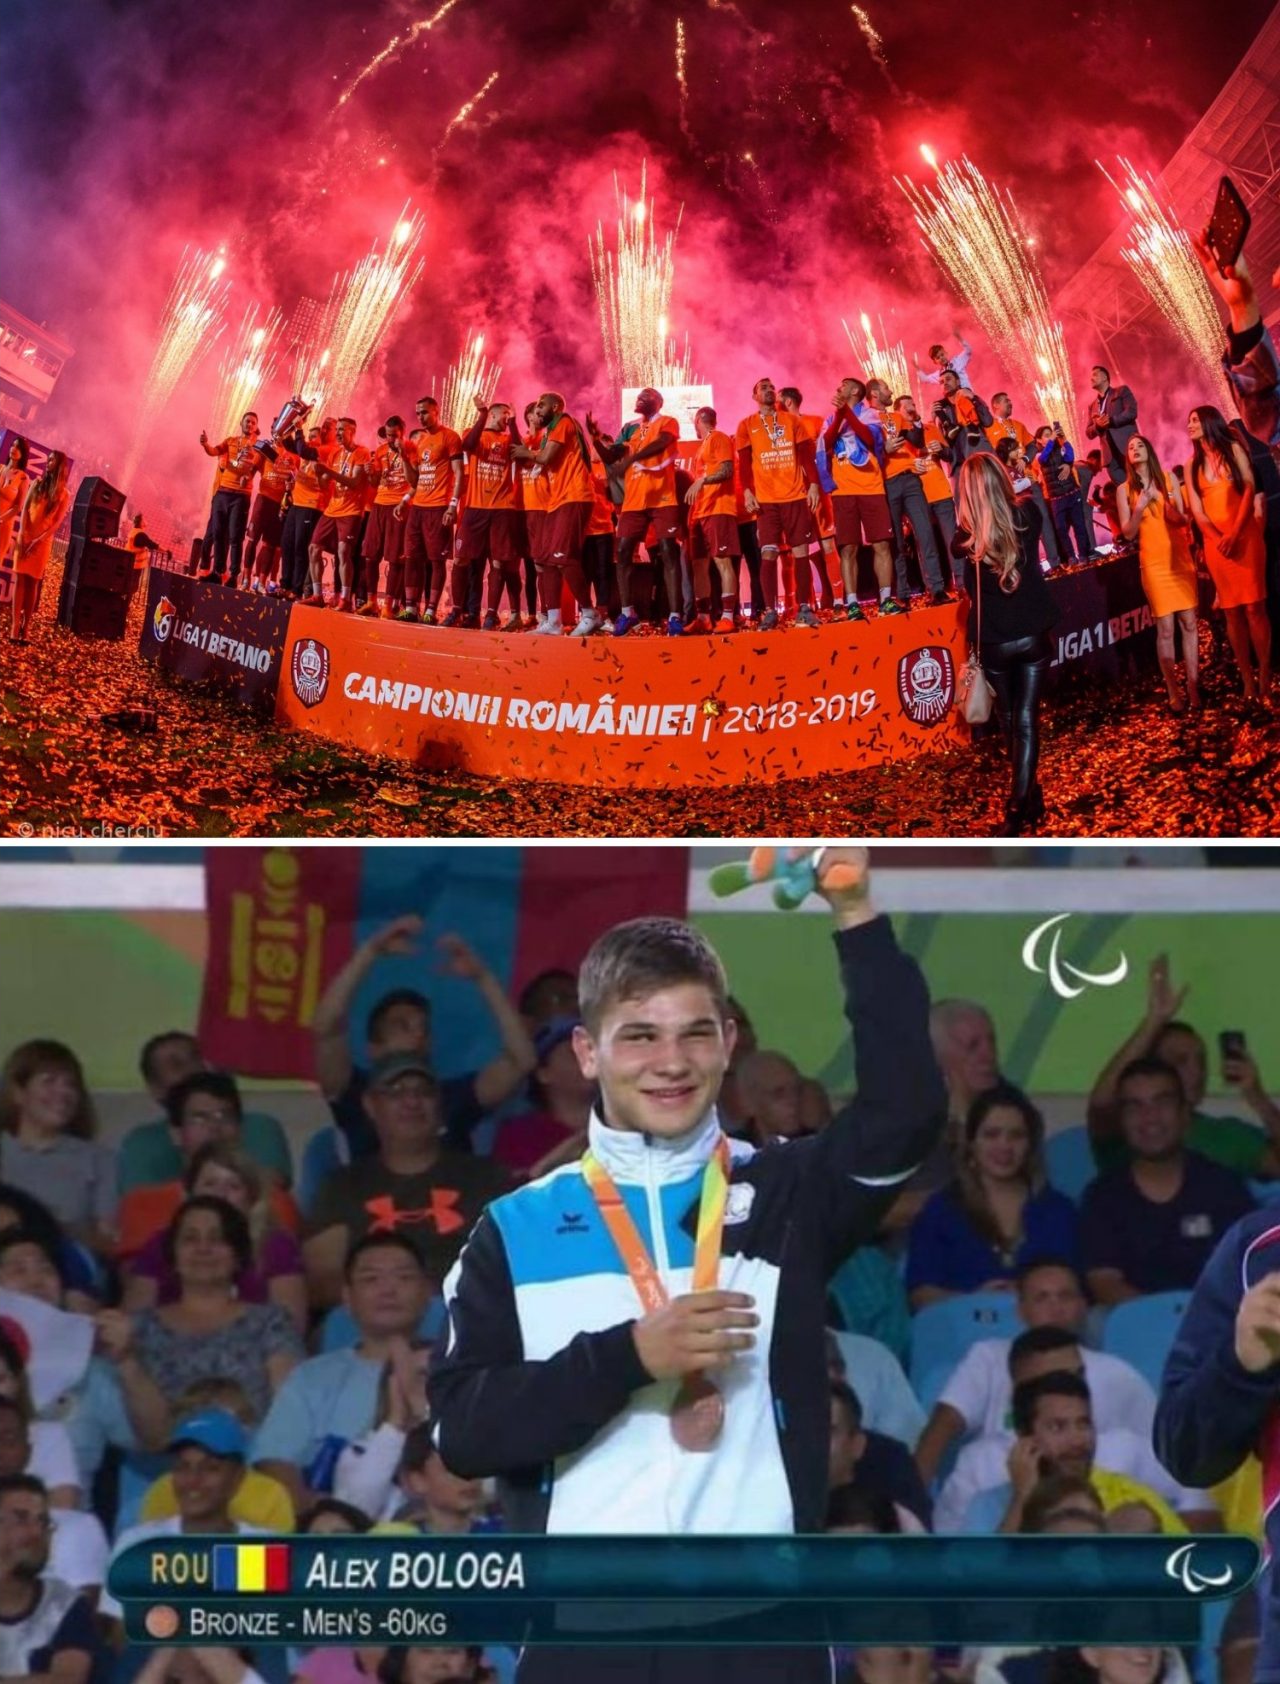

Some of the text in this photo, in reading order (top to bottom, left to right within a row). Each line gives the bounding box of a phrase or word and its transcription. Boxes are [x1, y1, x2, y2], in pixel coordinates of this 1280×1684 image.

[207, 632, 271, 674] BETANO
[1050, 604, 1157, 667] IGA1 BETA
[343, 672, 503, 726] CAMPIONII
[506, 693, 697, 736] ROMÂNIEI
[723, 688, 877, 734] 2018-2019
